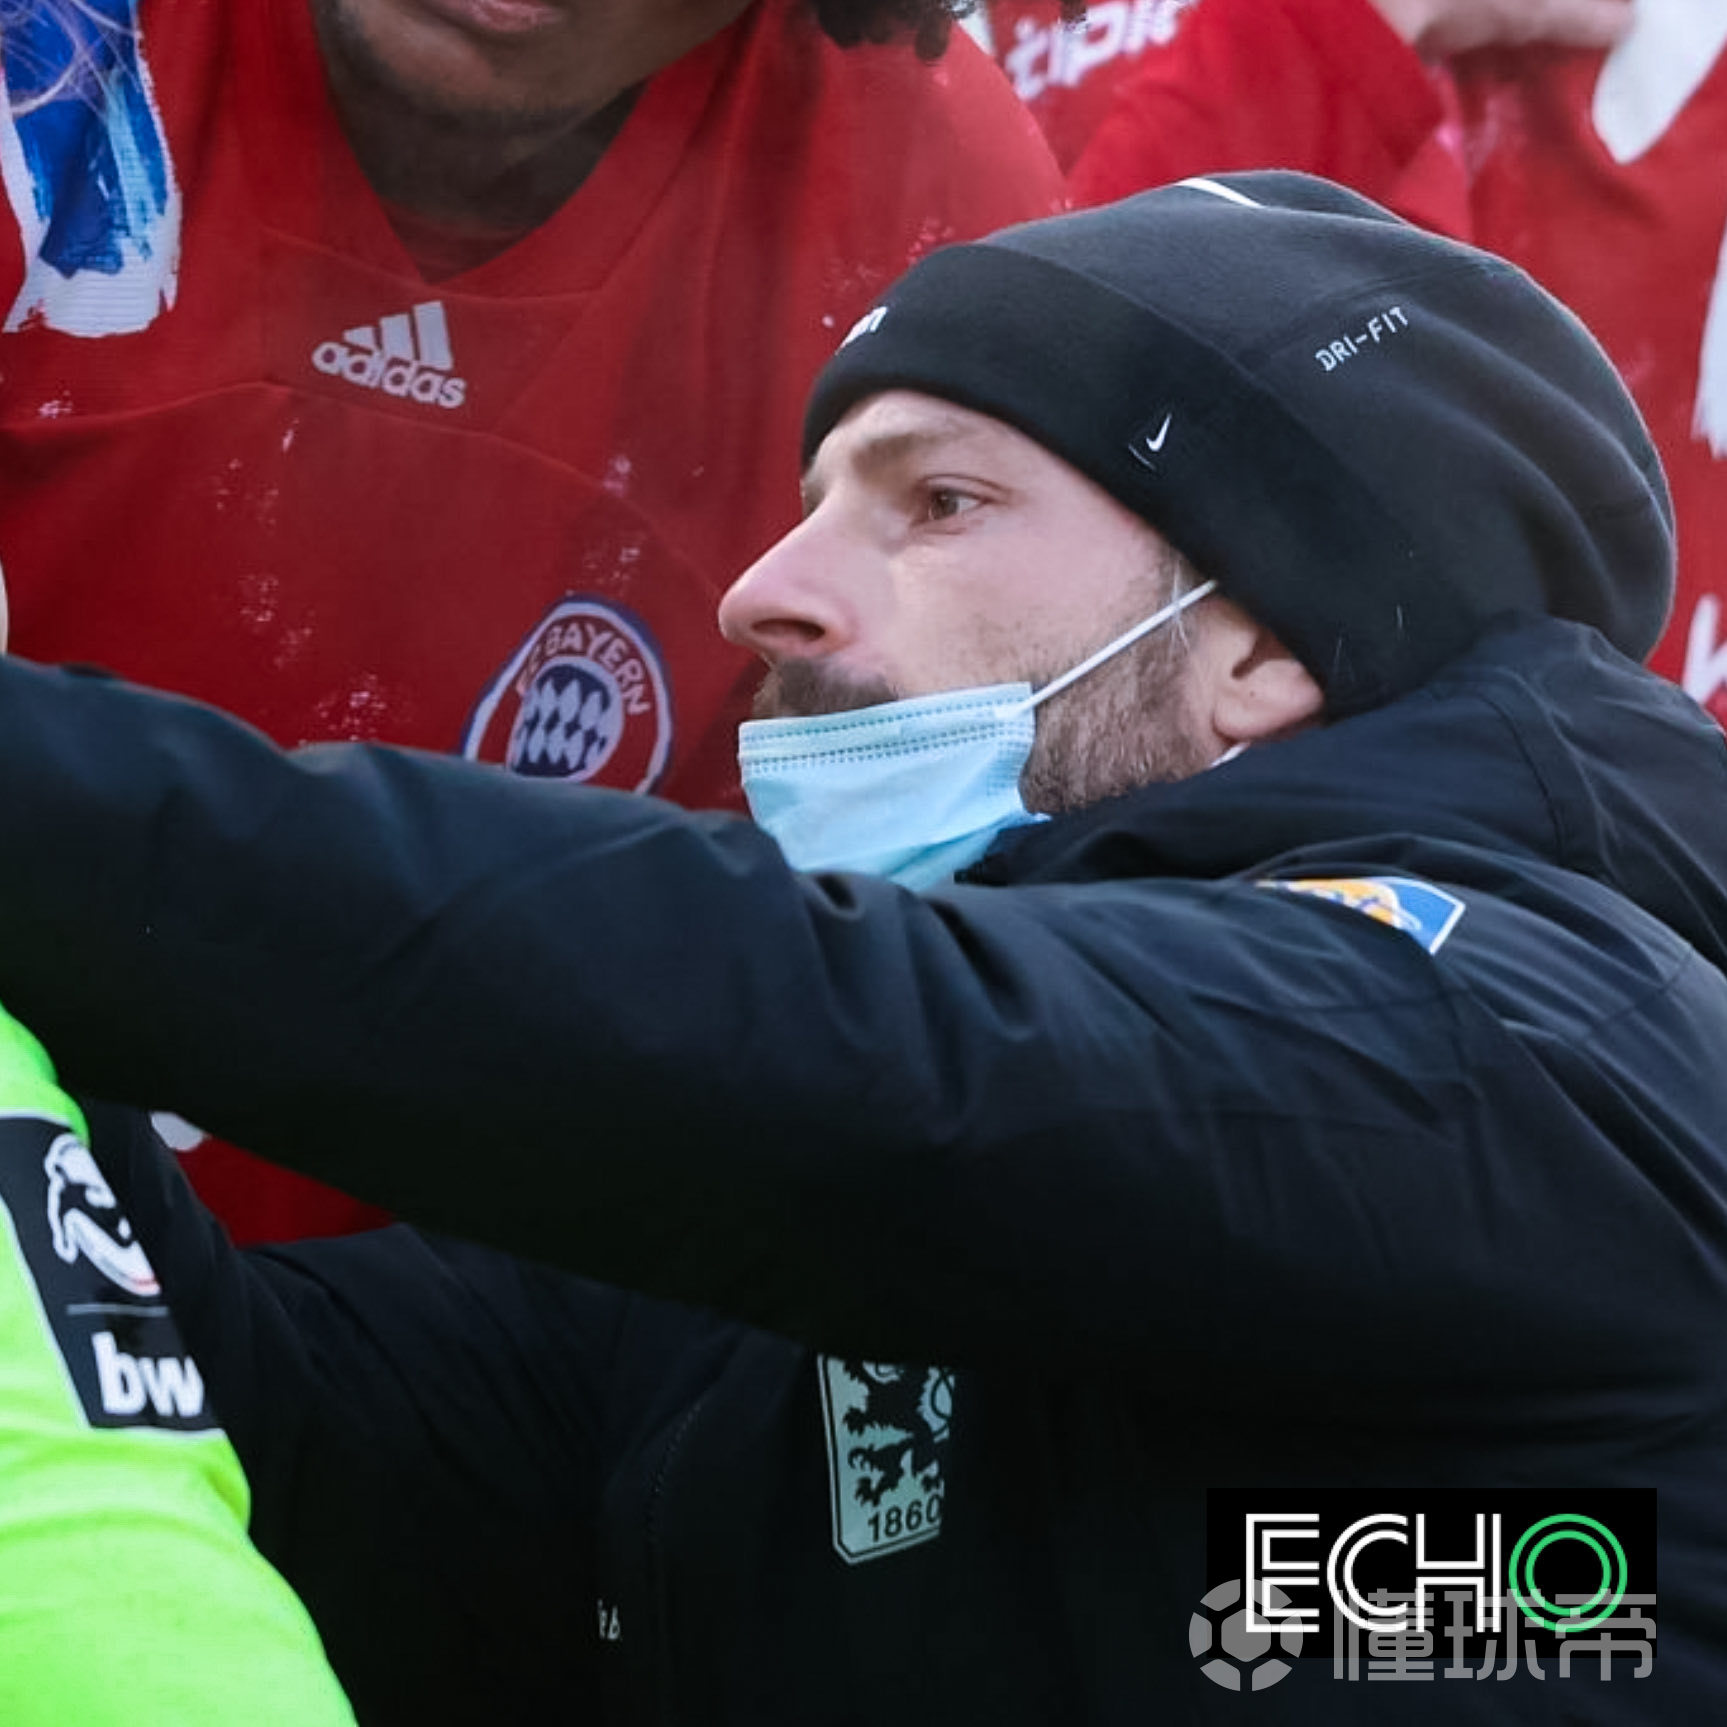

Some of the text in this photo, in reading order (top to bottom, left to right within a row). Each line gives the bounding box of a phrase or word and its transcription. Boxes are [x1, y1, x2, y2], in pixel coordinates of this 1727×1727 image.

[1315, 306, 1408, 371] DRI-FIT
[312, 341, 467, 409] adidas
[544, 622, 651, 715] BAYERN
[867, 1493, 942, 1543] 1860
